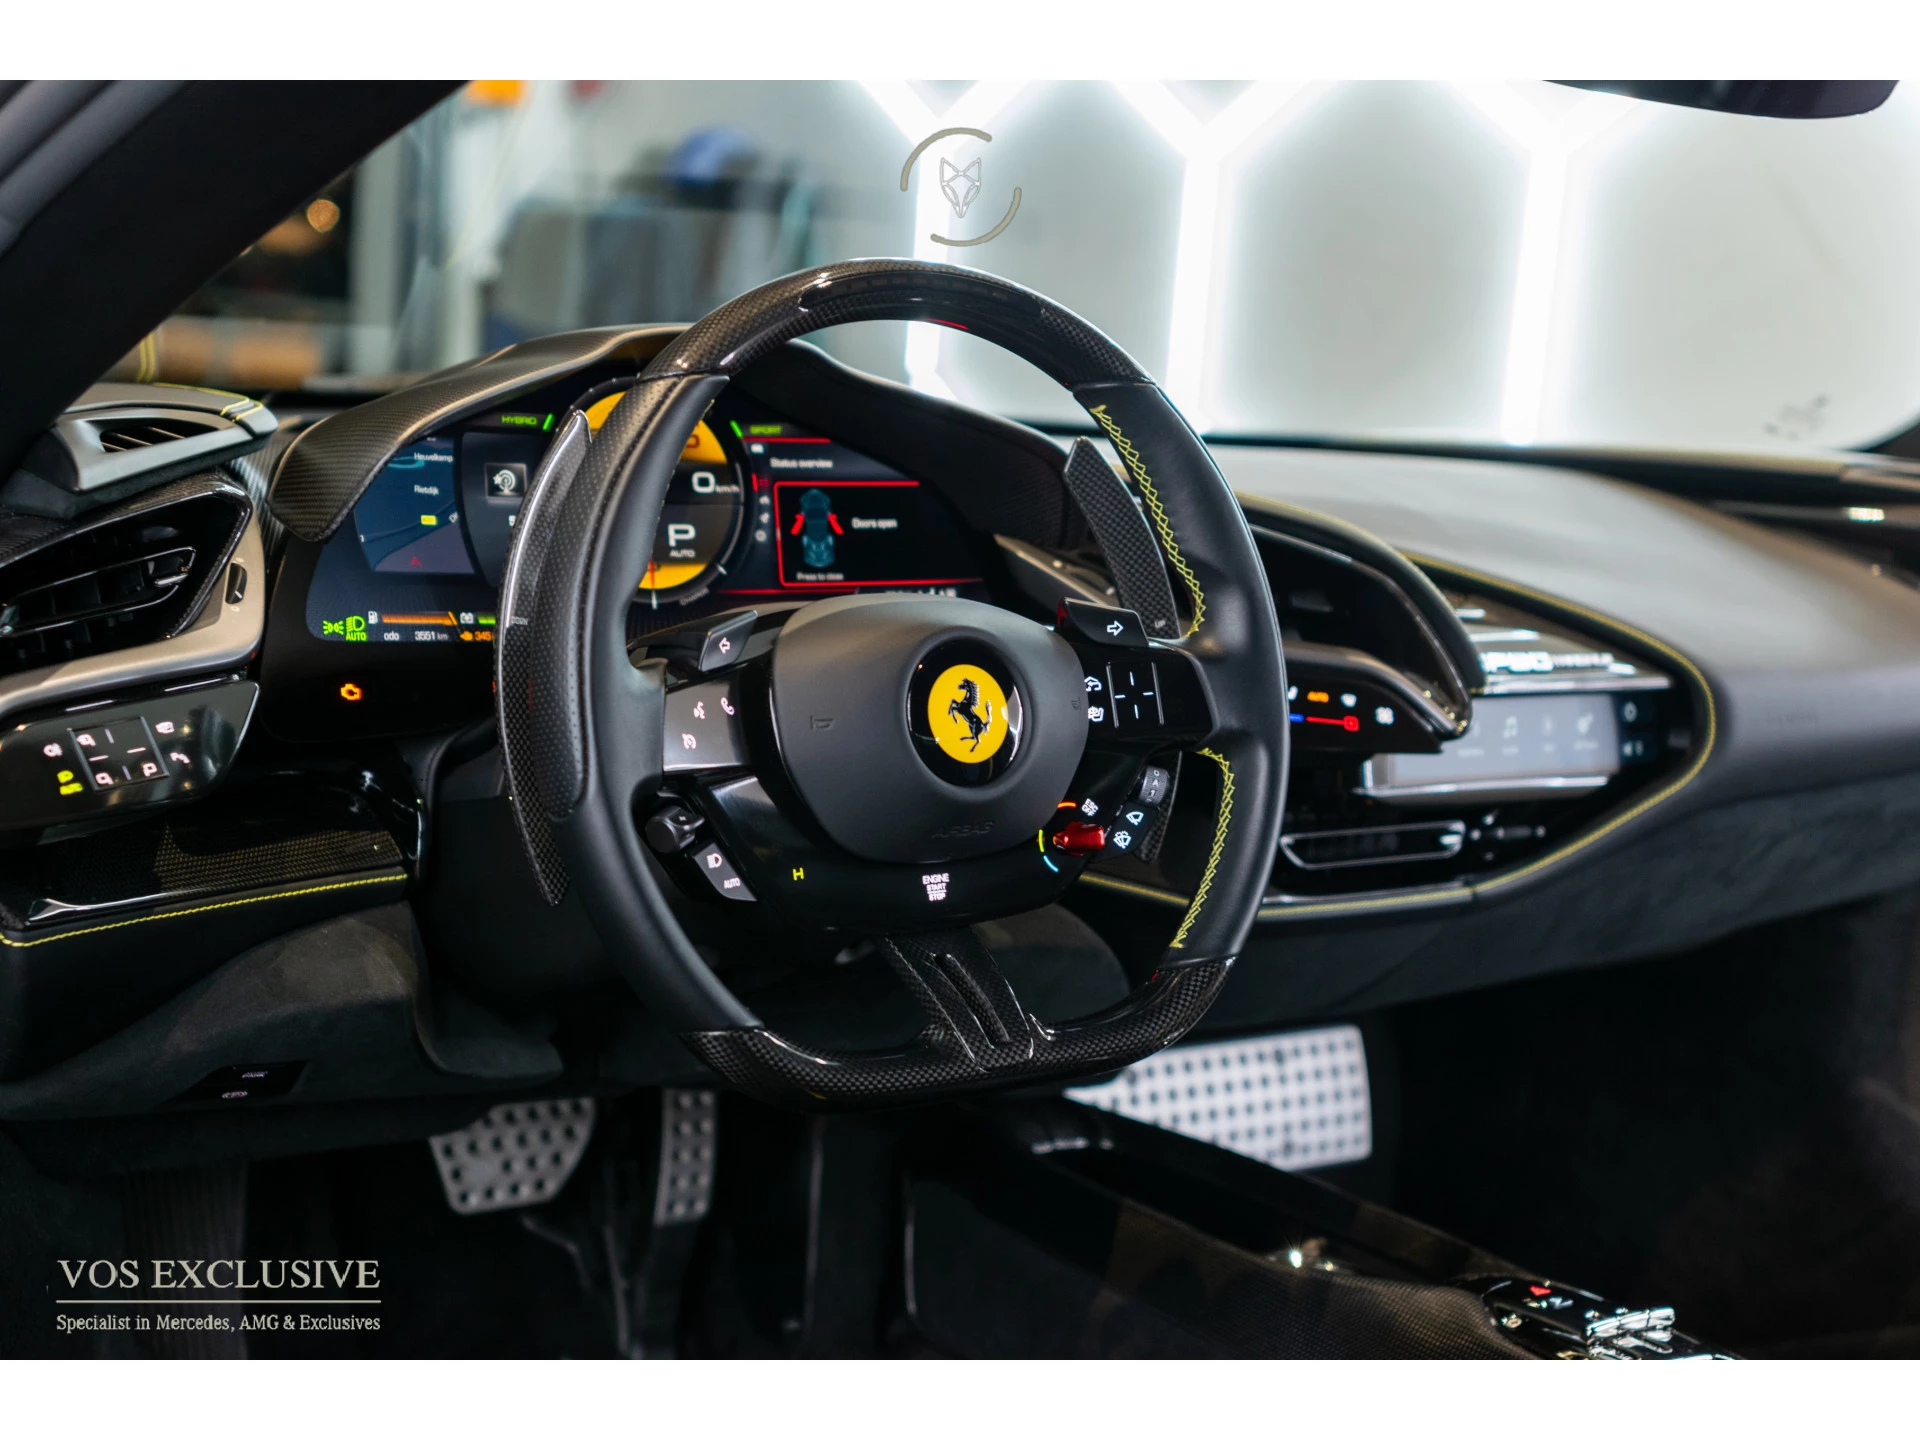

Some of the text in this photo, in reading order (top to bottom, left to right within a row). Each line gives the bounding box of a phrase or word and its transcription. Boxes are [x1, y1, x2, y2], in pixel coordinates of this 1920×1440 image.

[502, 416, 537, 426] HYBRID
[770, 457, 833, 468] Status overview
[692, 471, 716, 493] 0
[852, 517, 897, 530] Doors open
[668, 524, 696, 547] P
[669, 549, 696, 558] AUTO
[510, 616, 528, 626] DOWN
[1154, 619, 1166, 628] UP
[346, 632, 367, 641] AUTO
[383, 631, 448, 641] odo 3551 km
[1152, 778, 1160, 787] A
[792, 867, 804, 881] H
[922, 873, 950, 885] ENGINE
[723, 877, 741, 889] AUTO
[926, 882, 947, 892] START
[928, 892, 946, 902] STOP
